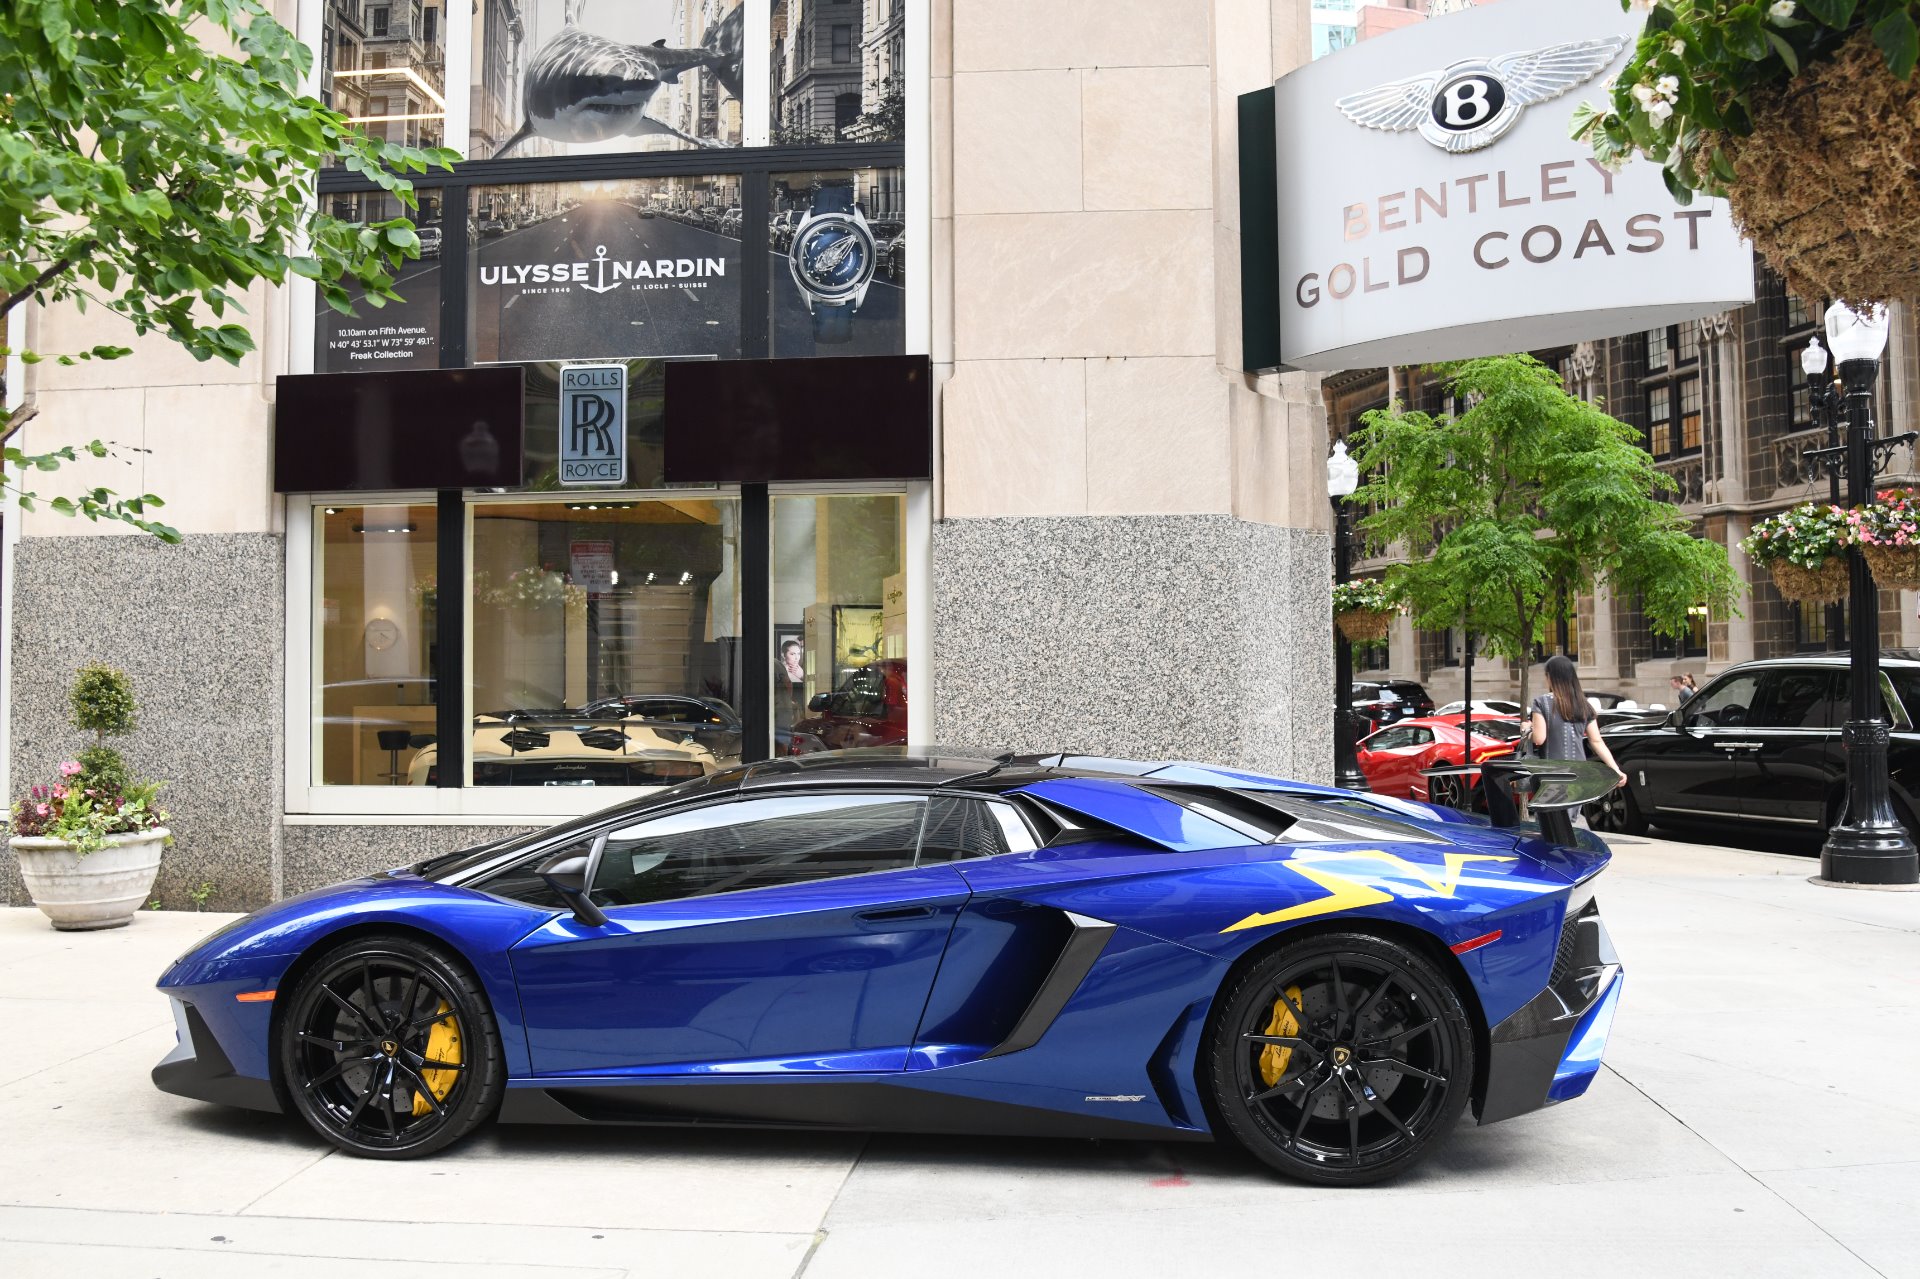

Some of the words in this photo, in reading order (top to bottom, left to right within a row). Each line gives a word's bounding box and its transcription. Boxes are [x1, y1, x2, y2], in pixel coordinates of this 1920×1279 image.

[1343, 157, 1614, 242] BENTLEY
[1296, 246, 1430, 309] GOLD
[1473, 210, 1712, 270] COAST
[480, 263, 590, 285] ULYSSE
[612, 258, 726, 279] NARDIN
[338, 329, 367, 337] 10.10am
[379, 326, 397, 336] Fifth
[397, 326, 427, 335] Avenue.
[329, 341, 336, 349] N
[381, 339, 390, 347] W
[350, 351, 373, 360] Freak
[373, 350, 414, 359] Collection
[567, 373, 618, 387] ROLLS
[566, 463, 617, 477] ROYCE
